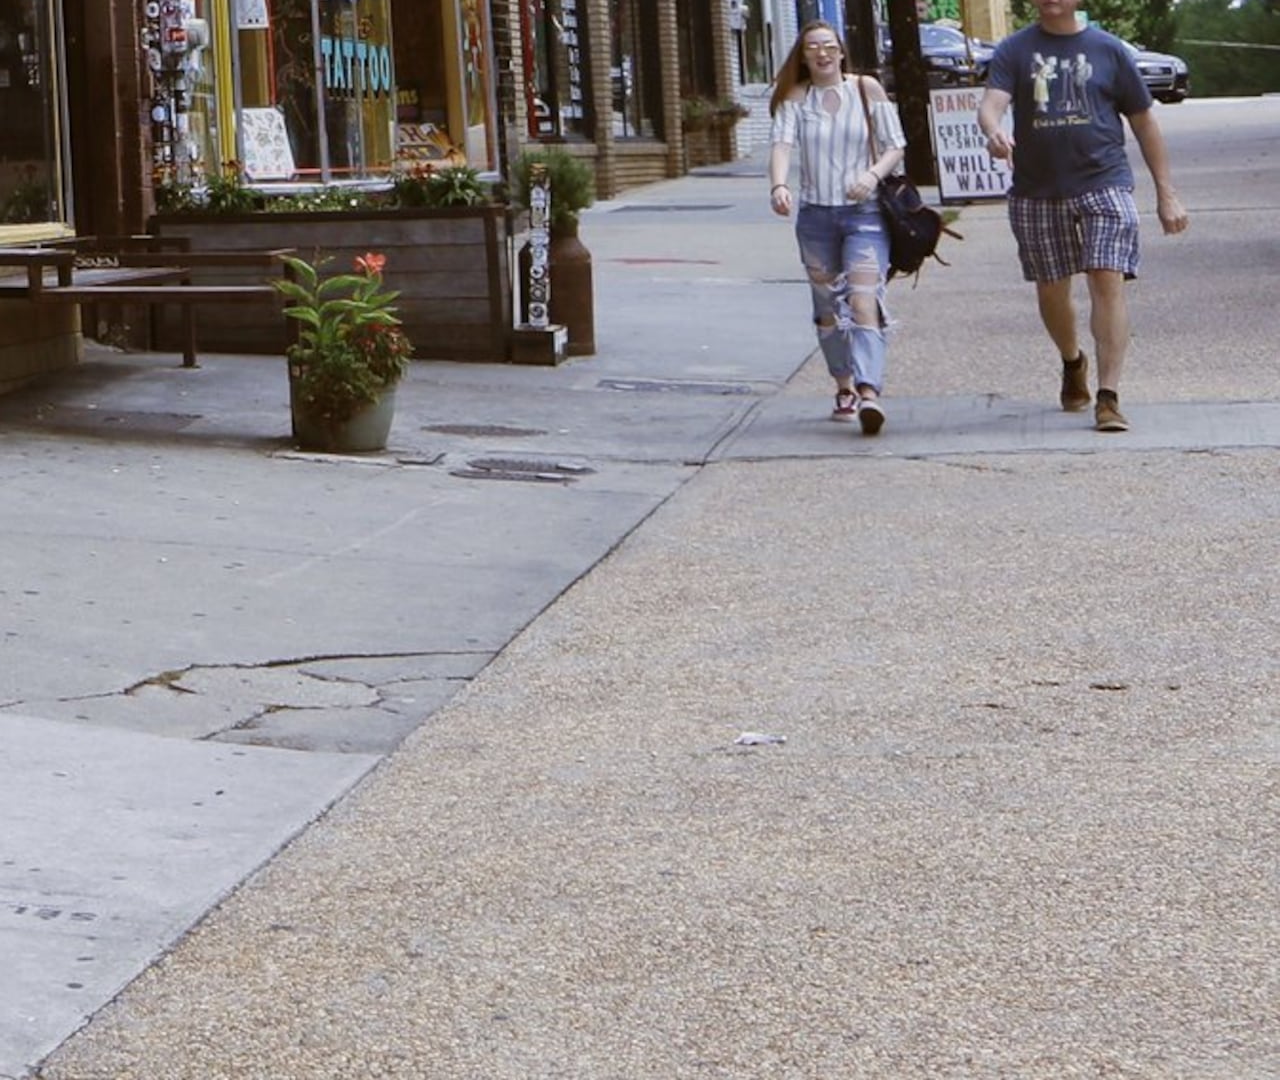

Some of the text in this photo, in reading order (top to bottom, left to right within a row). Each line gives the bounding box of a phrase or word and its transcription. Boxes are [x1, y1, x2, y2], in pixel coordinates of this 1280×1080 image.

[320, 37, 391, 92] TATTOO
[938, 124, 979, 137] CUSTO
[942, 154, 998, 174] WHILE
[956, 172, 1005, 191] WAIT
